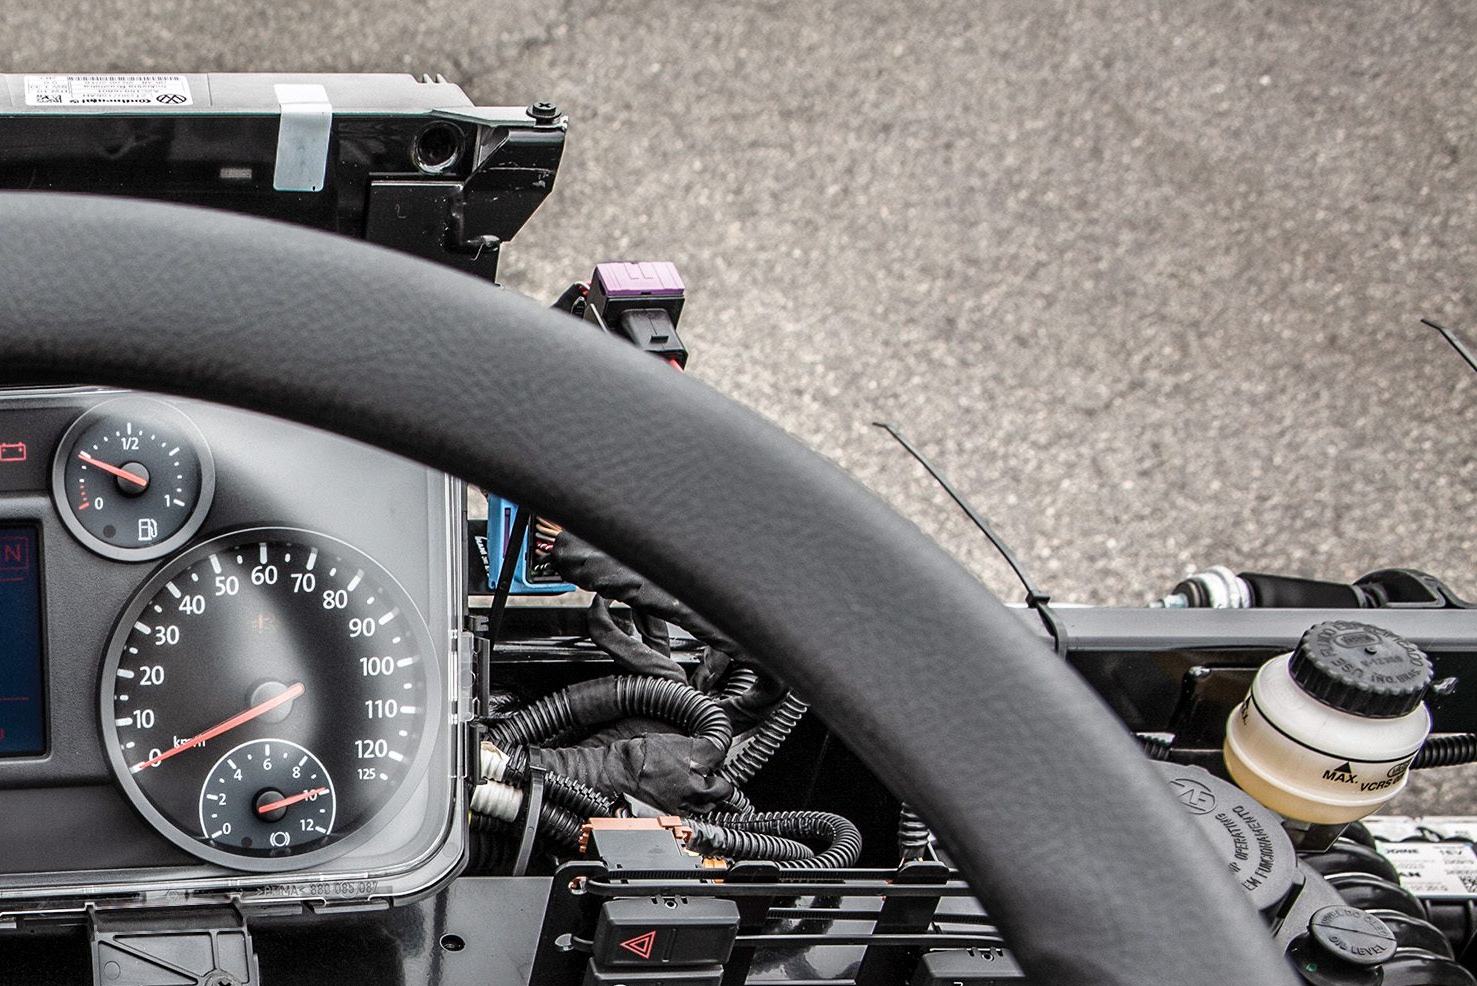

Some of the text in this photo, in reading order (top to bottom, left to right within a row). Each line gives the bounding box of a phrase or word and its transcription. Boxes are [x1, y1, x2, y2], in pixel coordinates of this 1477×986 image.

[121, 437, 139, 450] 1/2
[94, 497, 103, 510] 0
[164, 494, 170, 508] 1
[251, 566, 277, 585] 60
[291, 574, 316, 593] 70
[214, 576, 239, 595] 50
[178, 595, 205, 615] 40
[323, 590, 348, 609] 80
[155, 626, 179, 645] 30
[349, 618, 375, 637] 90
[139, 665, 165, 685] 20
[360, 656, 394, 676] 100
[365, 699, 397, 718] 110
[133, 710, 154, 729] 10
[149, 749, 162, 767] 0
[355, 739, 388, 759] 120
[263, 759, 272, 771] 6
[292, 766, 301, 779] 8
[358, 768, 376, 780] 125
[233, 768, 243, 781] 4
[1322, 769, 1359, 785] MAX.
[219, 793, 227, 805] 2
[222, 823, 231, 835] 0
[300, 819, 314, 831] 12
[1351, 944, 1388, 956] LEVEL
